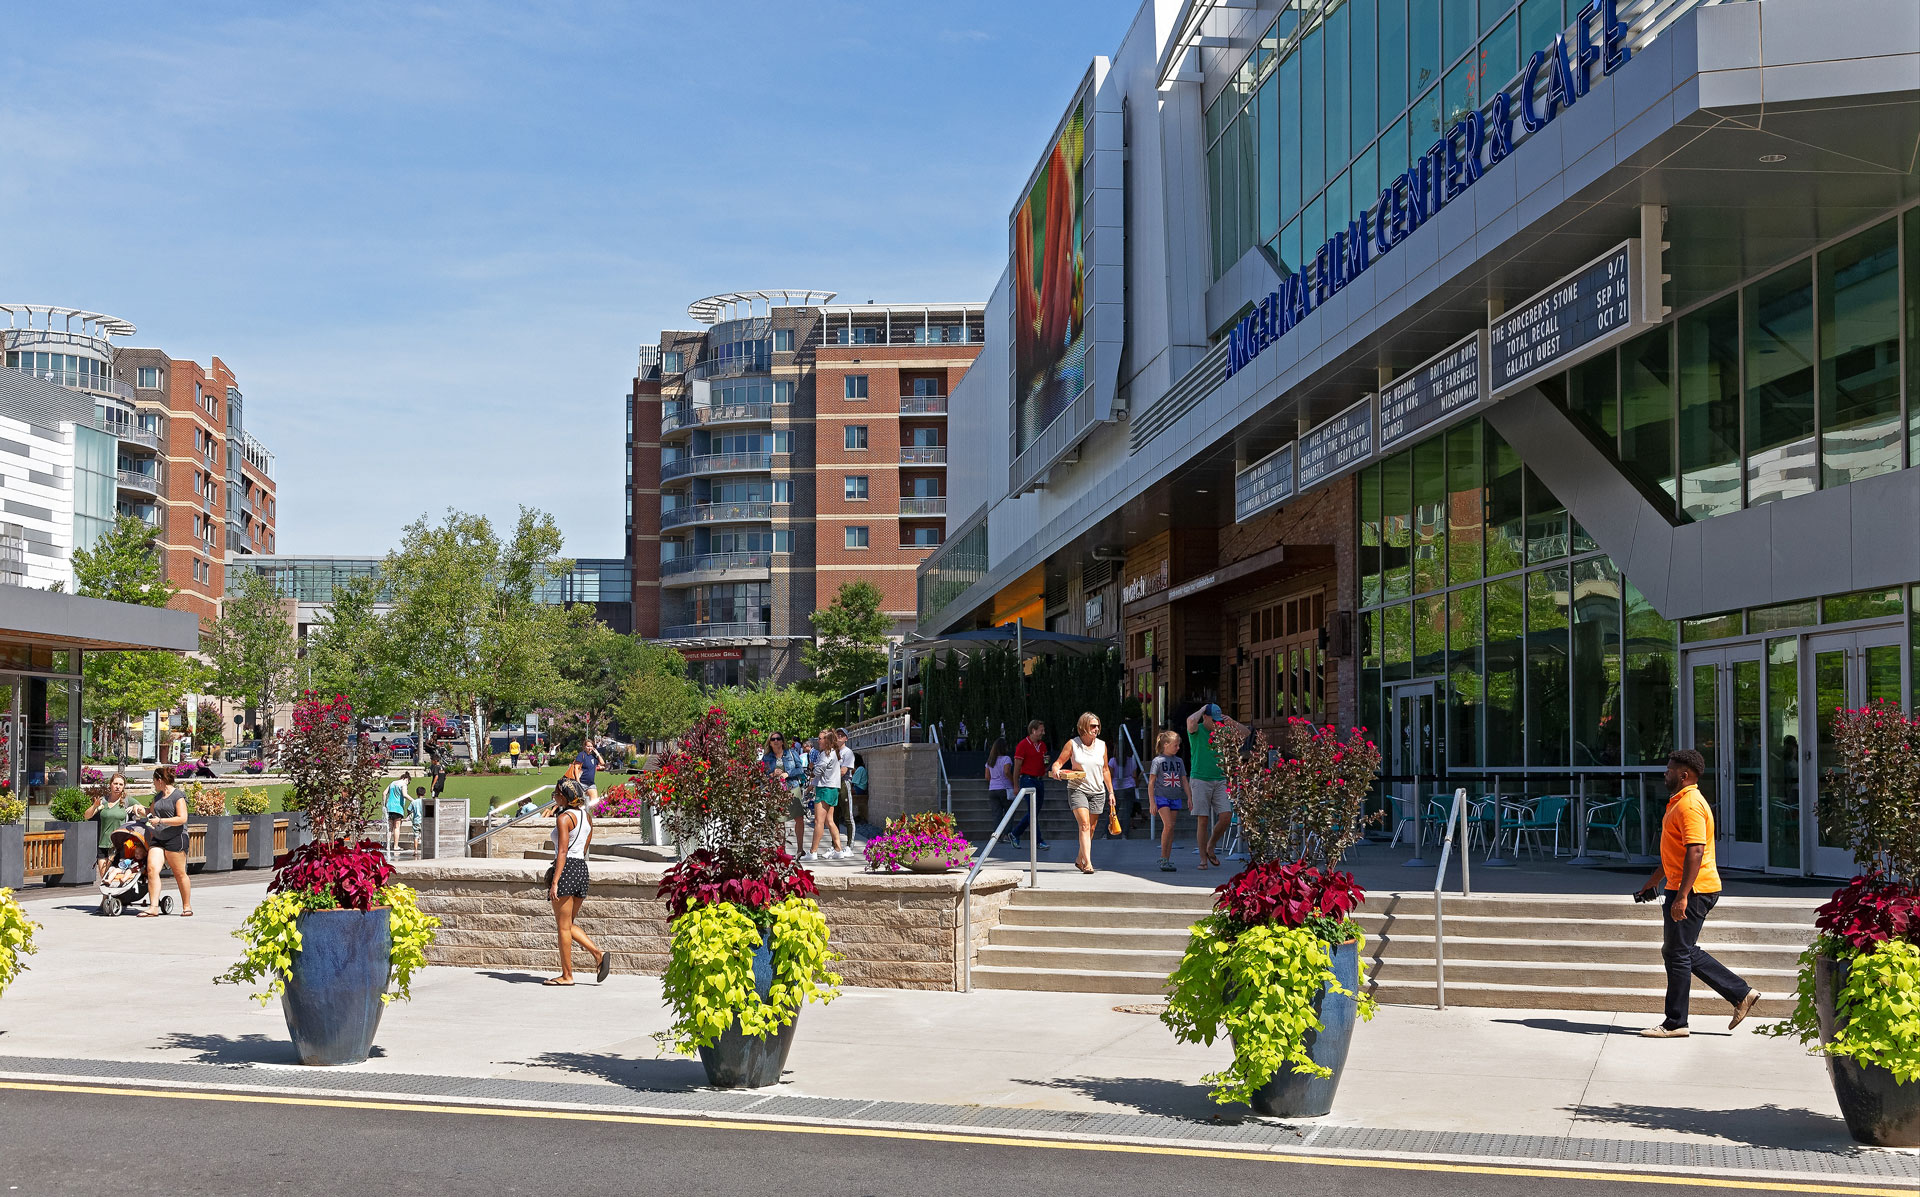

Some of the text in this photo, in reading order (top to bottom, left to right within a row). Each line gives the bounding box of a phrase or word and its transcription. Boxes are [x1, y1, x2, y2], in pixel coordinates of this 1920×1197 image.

[1225, 265, 1311, 382] ANGELIKA
[1315, 211, 1369, 308] FILM
[1375, 111, 1485, 255] CENTER
[1489, 92, 1515, 165] &
[1492, 254, 1625, 345] THE SORCERER'S STONE 9/7
[1506, 299, 1627, 378] GALAXY QUEST OCT 21
[1507, 279, 1625, 358] TOTAL RECALL SEP 16
[1381, 409, 1390, 426] THE
[1406, 393, 1419, 412] KING
[1432, 379, 1443, 397] THE
[1445, 362, 1476, 391] FAREWELL
[1382, 341, 1477, 408] THE WEDDING BRITTANY RUNS
[1161, 761, 1181, 772] GAP
